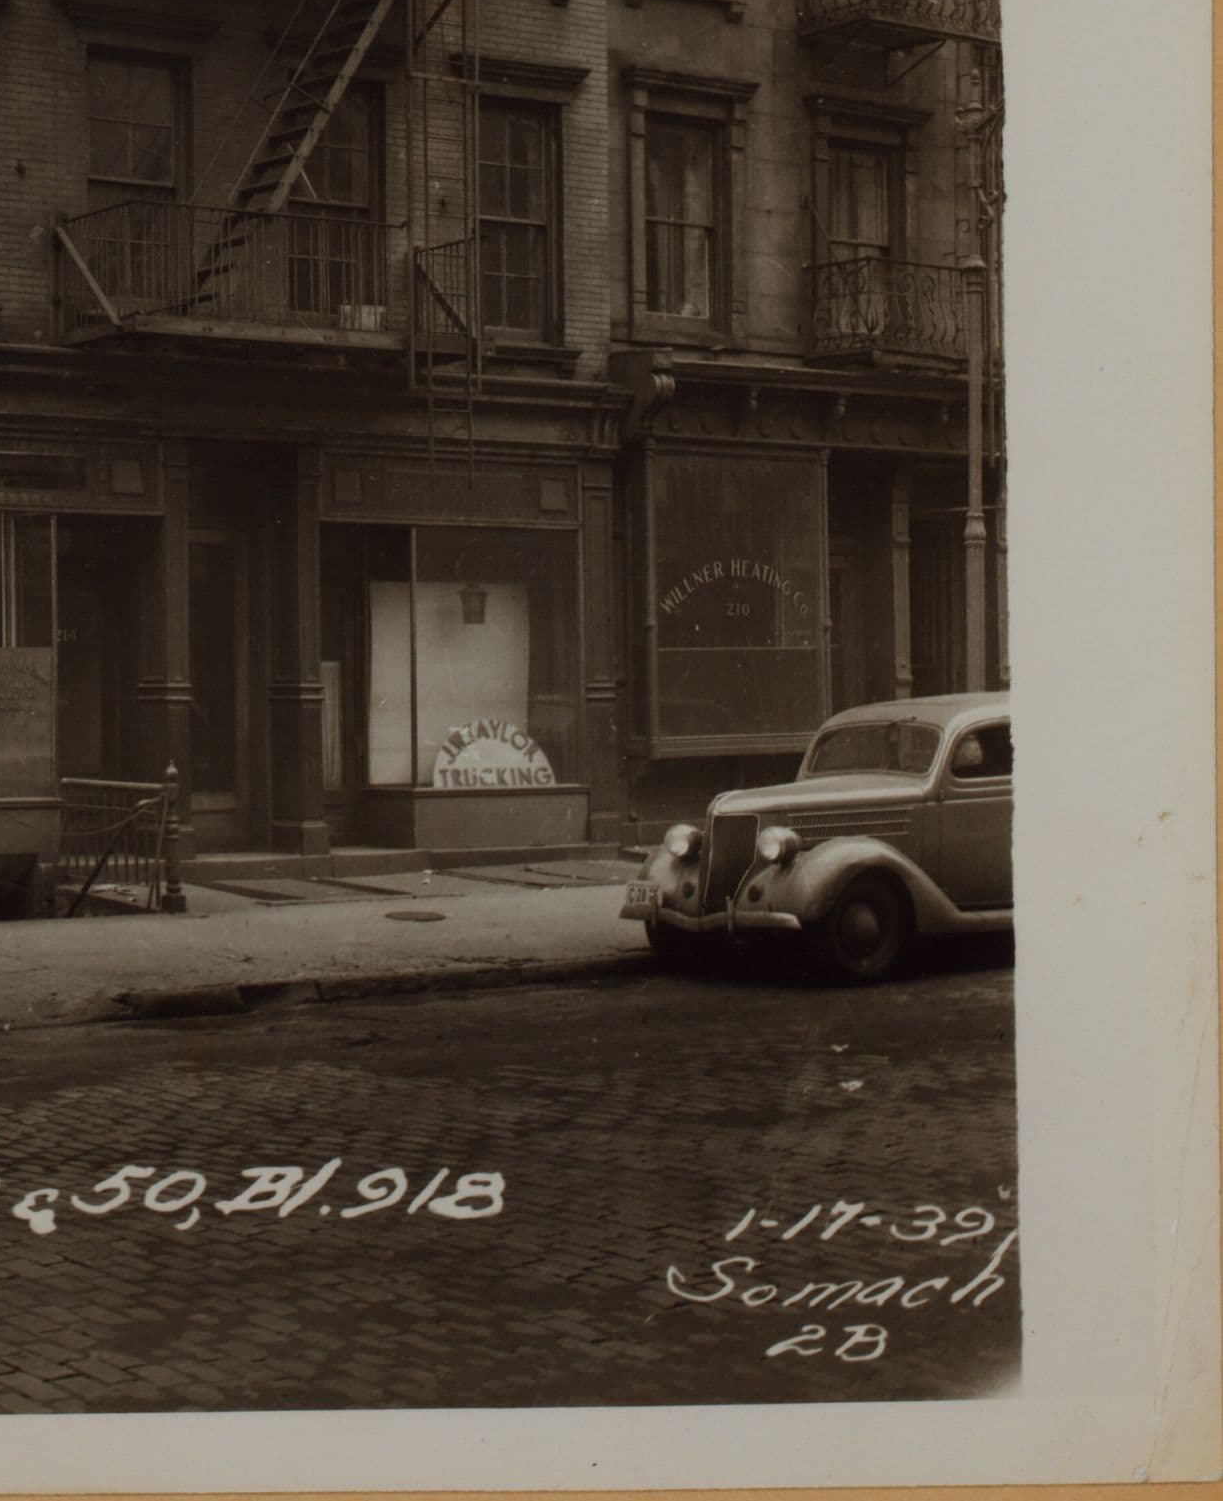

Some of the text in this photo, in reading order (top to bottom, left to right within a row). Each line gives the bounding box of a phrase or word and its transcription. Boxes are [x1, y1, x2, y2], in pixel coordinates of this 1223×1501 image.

[659, 560, 725, 616] WILLNER
[730, 557, 793, 597] HEATING
[726, 603, 751, 618] 210
[438, 766, 553, 788] TRUCKING
